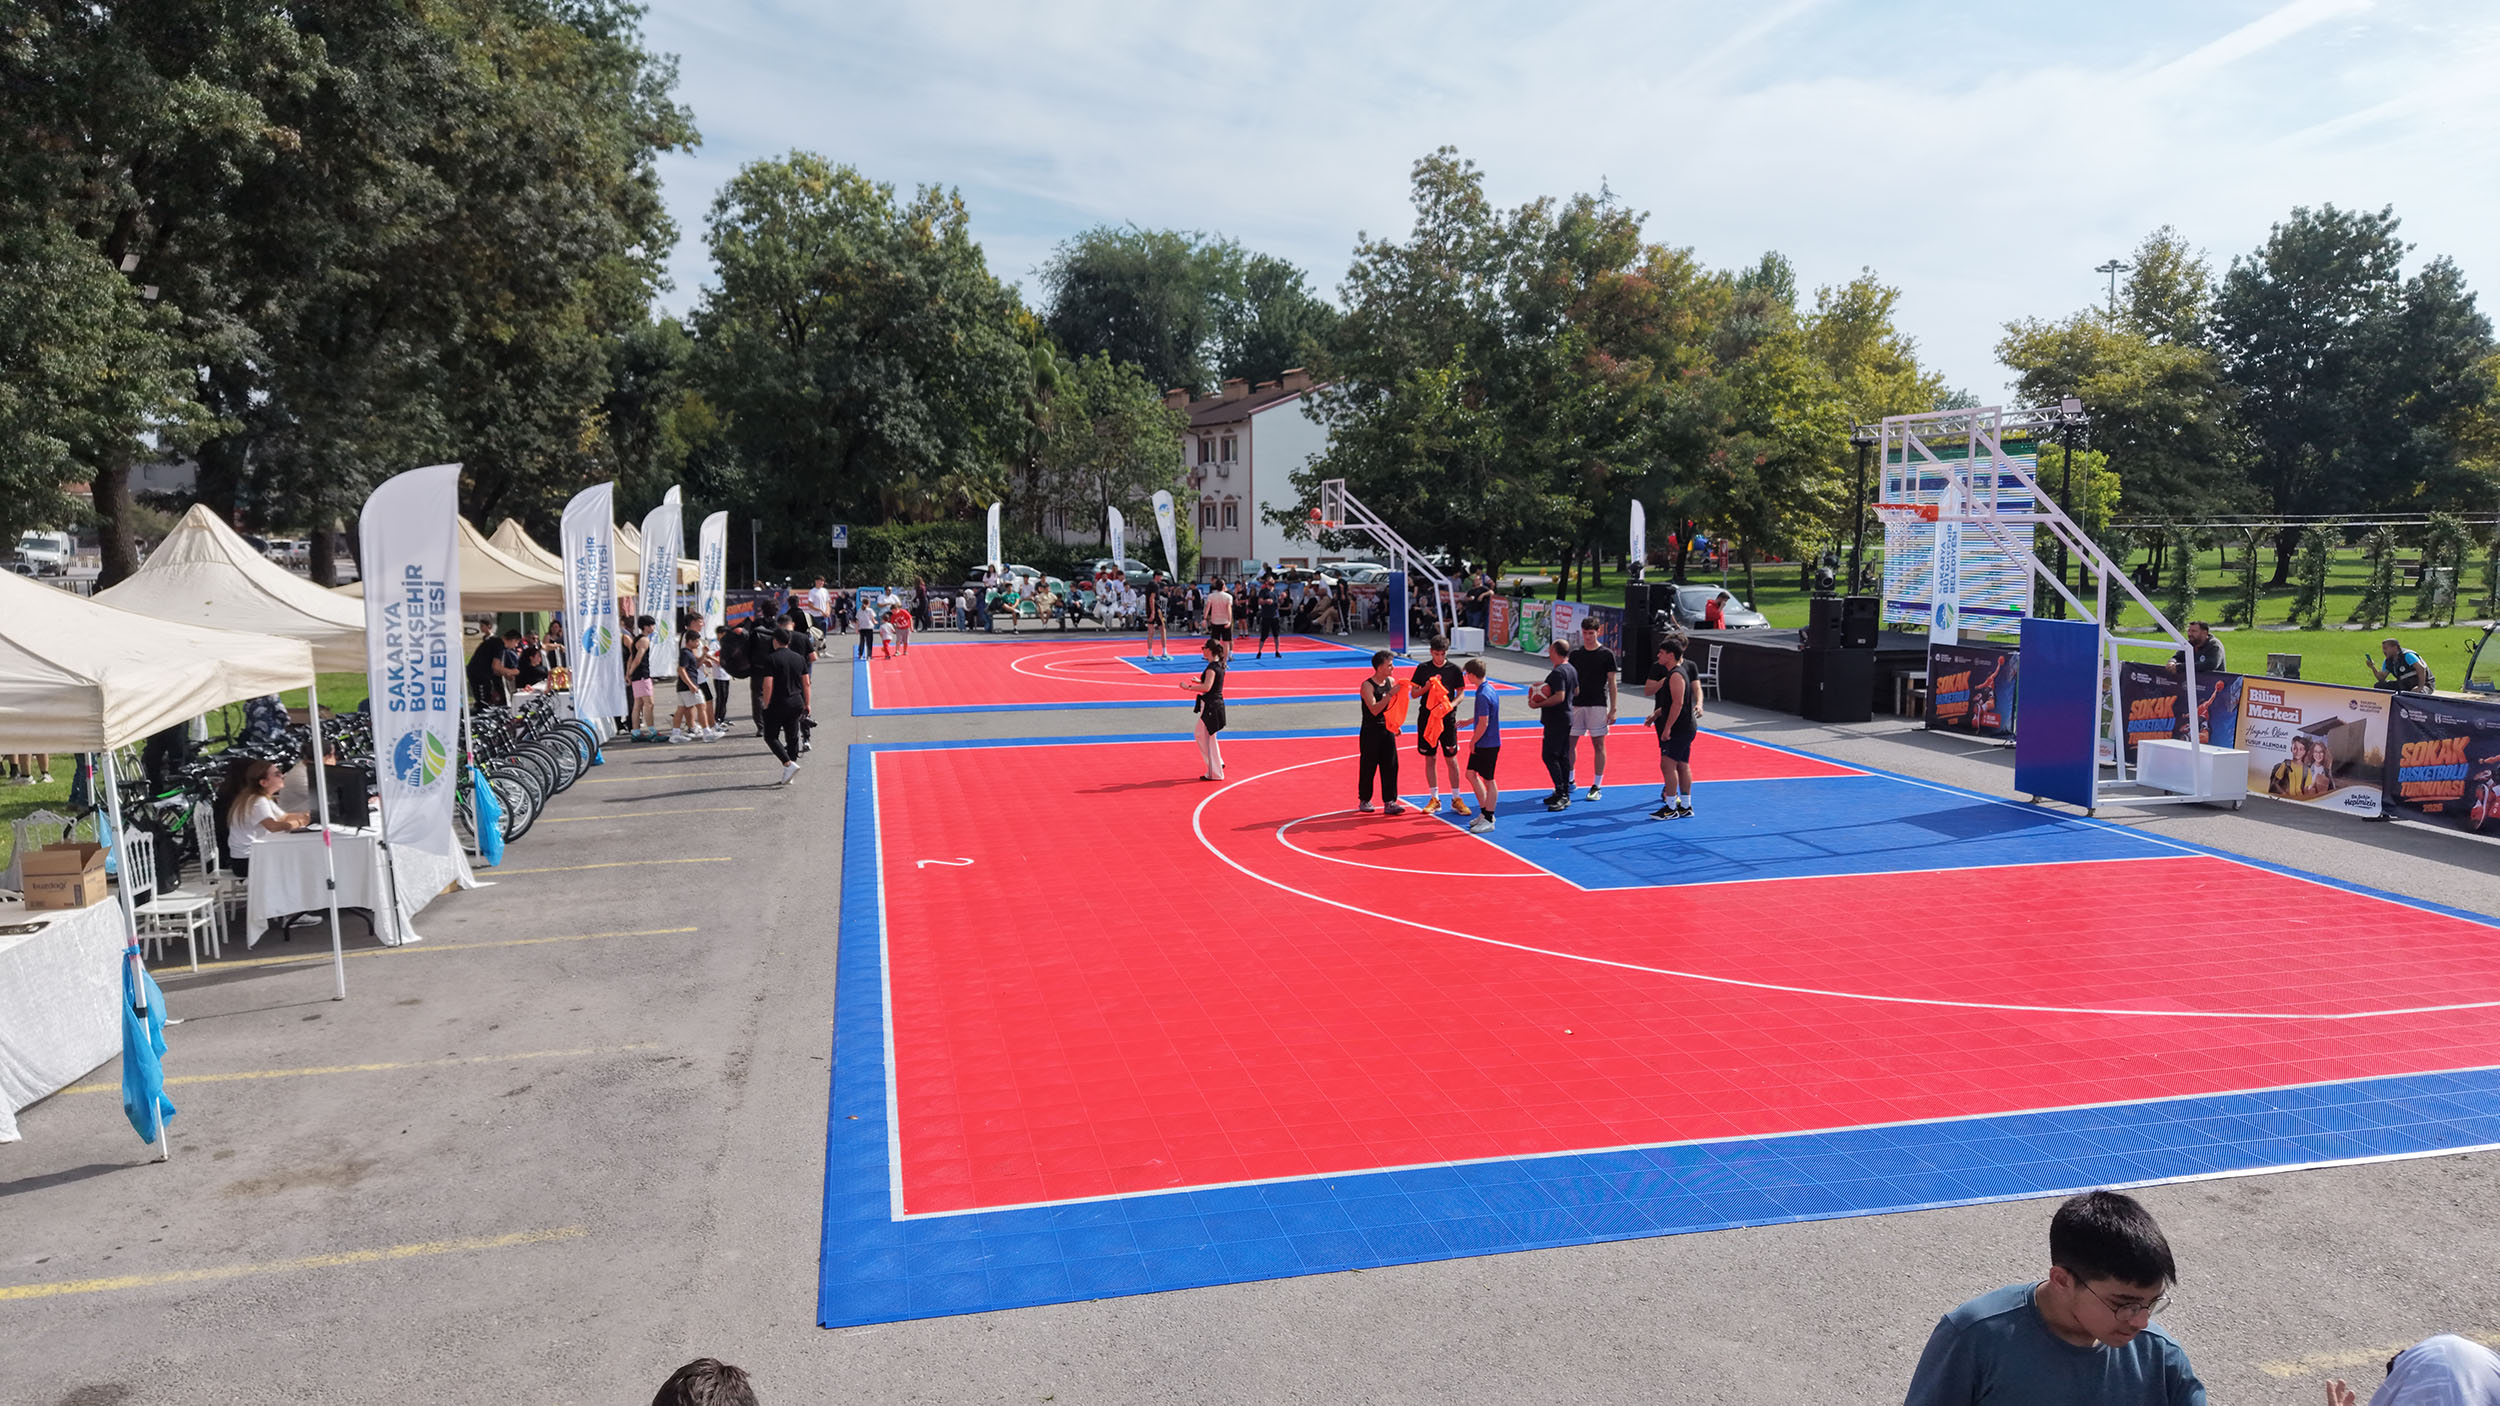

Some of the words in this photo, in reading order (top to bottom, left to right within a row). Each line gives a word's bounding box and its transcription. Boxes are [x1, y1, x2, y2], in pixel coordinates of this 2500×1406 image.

[577, 557, 588, 616] SAKARYA
[403, 565, 427, 712] BÜYÜKŞEHİR
[425, 581, 447, 712] BELEDİYESİ
[384, 601, 406, 712] SAKARYA
[2129, 695, 2177, 720] SOKAK
[2249, 688, 2282, 705] Bilim
[2248, 705, 2300, 723] Merkezi
[2262, 741, 2288, 750] ALEMDAR
[2400, 736, 2471, 768] SOKAK
[2397, 763, 2470, 783] BASKETBOLU
